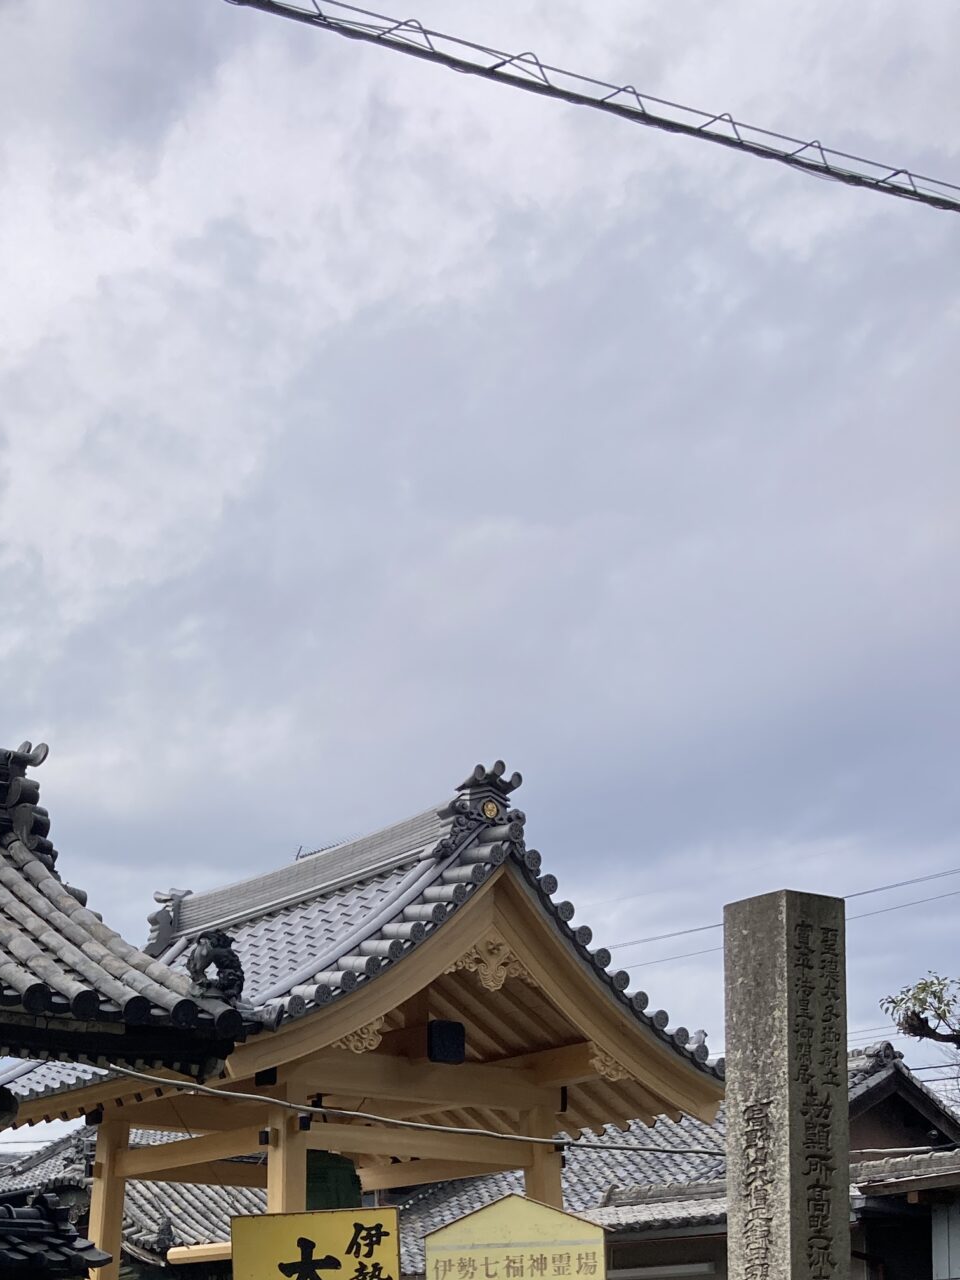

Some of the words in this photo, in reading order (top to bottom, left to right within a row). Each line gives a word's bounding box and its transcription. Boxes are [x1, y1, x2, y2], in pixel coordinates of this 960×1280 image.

[433, 1251, 599, 1280] 伊勢七福神霊場
